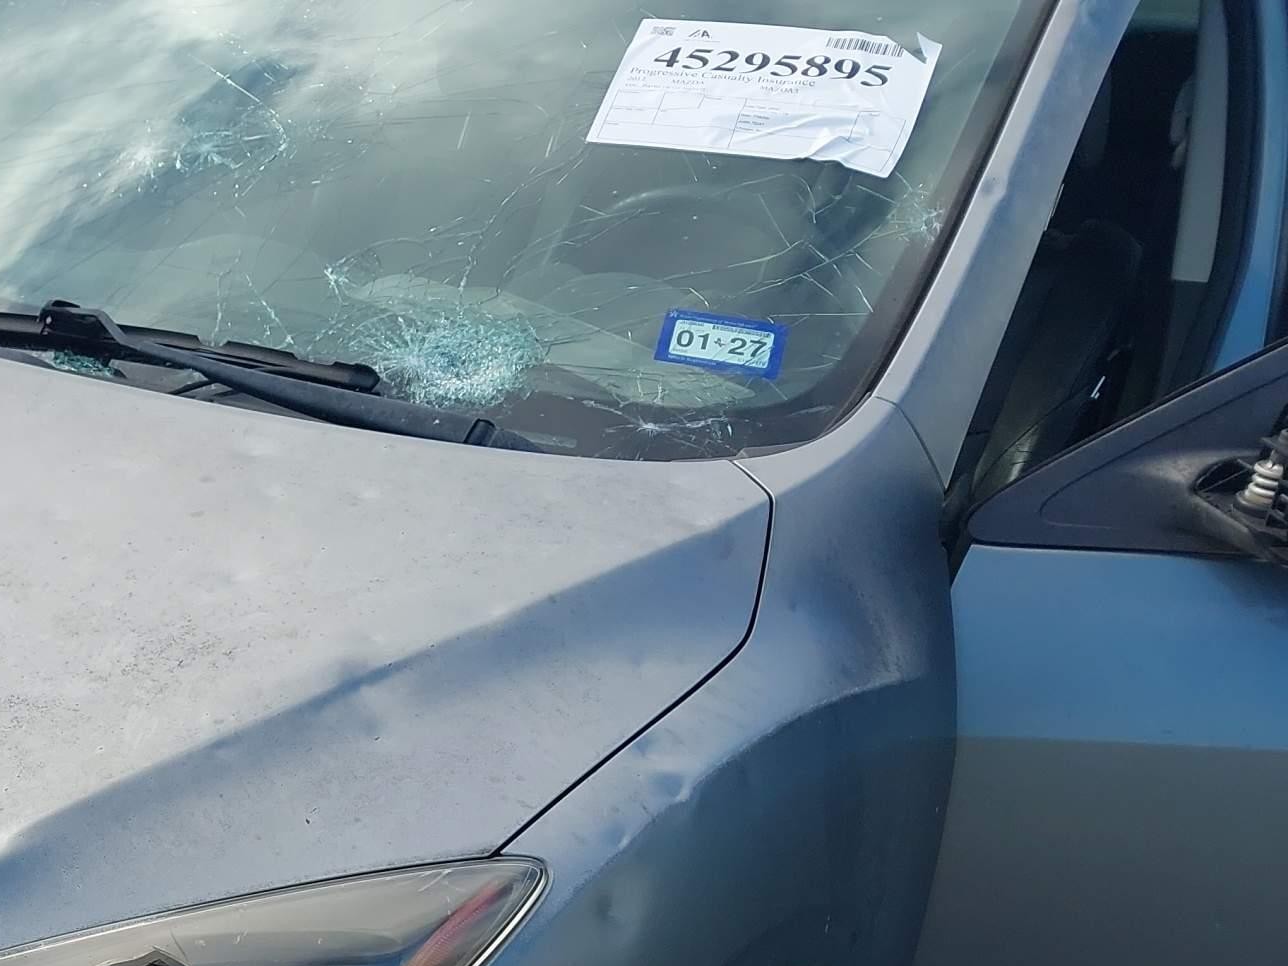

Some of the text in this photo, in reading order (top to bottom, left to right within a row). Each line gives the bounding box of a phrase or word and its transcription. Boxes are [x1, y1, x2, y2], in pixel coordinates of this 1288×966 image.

[630, 66, 698, 78] Progressive
[757, 76, 816, 87] Insurance
[653, 46, 893, 87] 45295895
[676, 329, 710, 350] 01
[727, 337, 767, 357] 27
